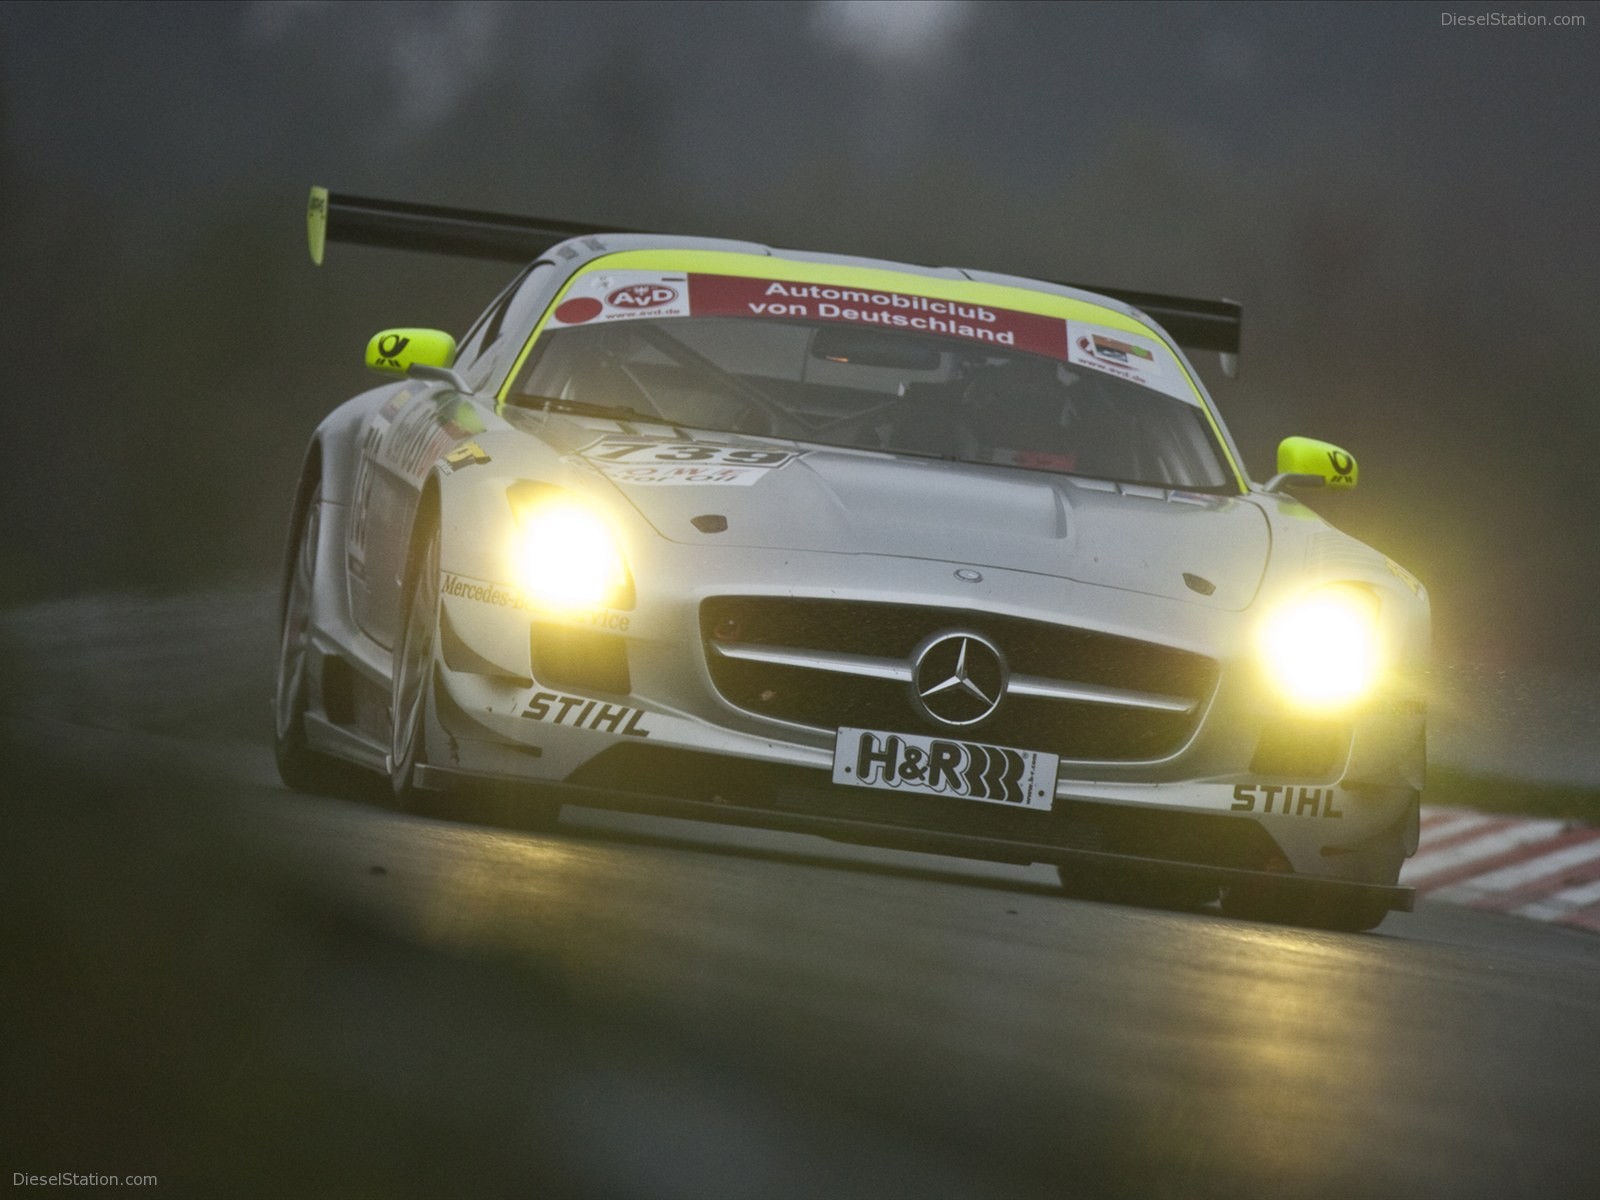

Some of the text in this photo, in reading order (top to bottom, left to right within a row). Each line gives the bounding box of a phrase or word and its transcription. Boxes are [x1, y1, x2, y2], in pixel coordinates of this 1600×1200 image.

[605, 308, 680, 319] www.avd.de
[613, 289, 674, 307] AvD
[765, 282, 996, 323] Automobilclub
[749, 303, 1014, 345] von Deutschland
[600, 443, 792, 464] 739
[521, 692, 650, 738] STIHL
[856, 732, 970, 796] H&R
[1231, 784, 1343, 818] STIHL
